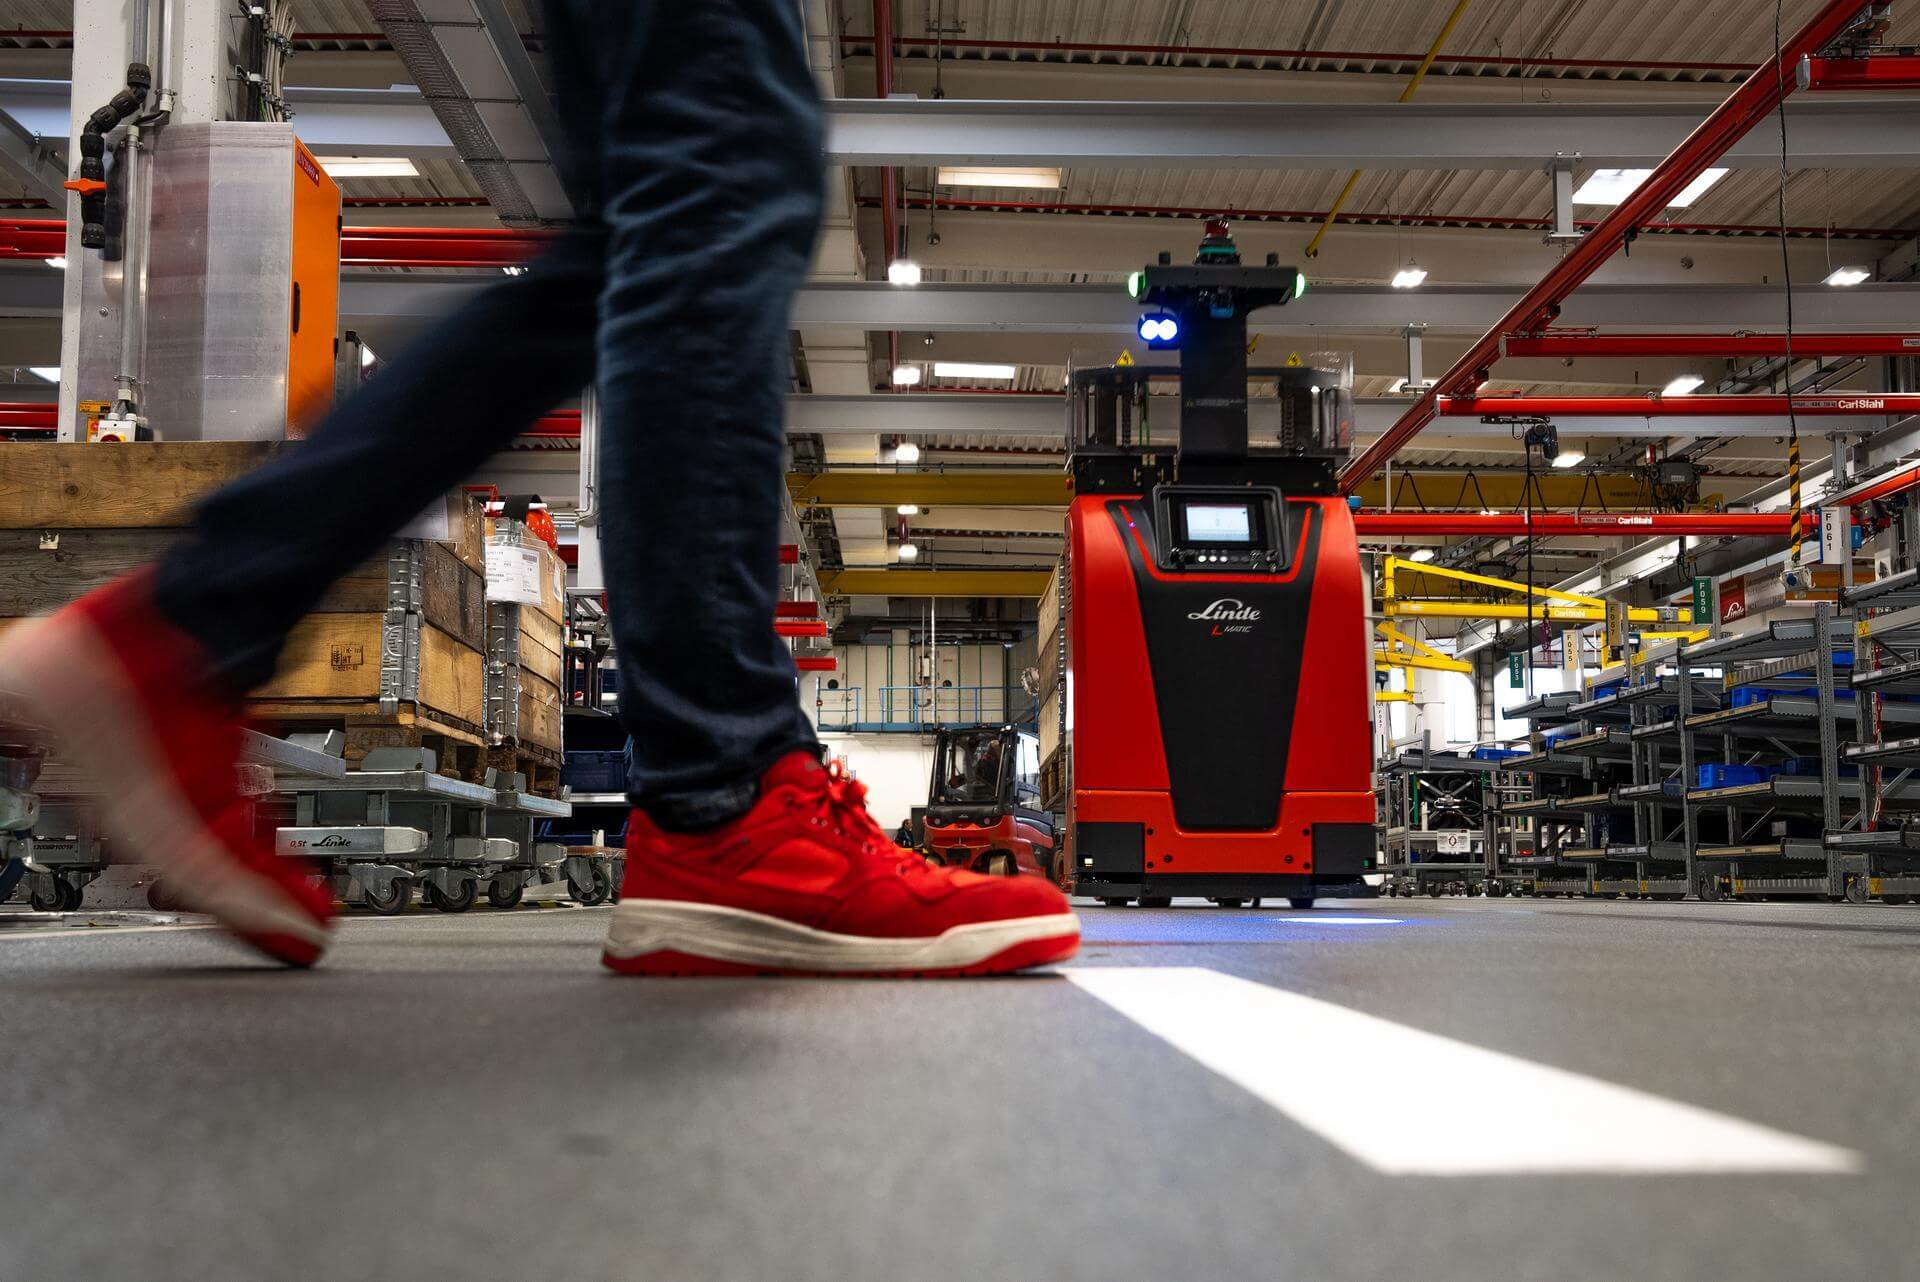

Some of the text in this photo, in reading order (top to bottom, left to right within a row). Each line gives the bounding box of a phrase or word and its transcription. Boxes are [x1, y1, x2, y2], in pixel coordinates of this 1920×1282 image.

[1824, 512, 1833, 551] F061
[1187, 598, 1261, 621] Linde
[1699, 582, 1707, 614] F059
[290, 834, 352, 848] 0,5t Linde
